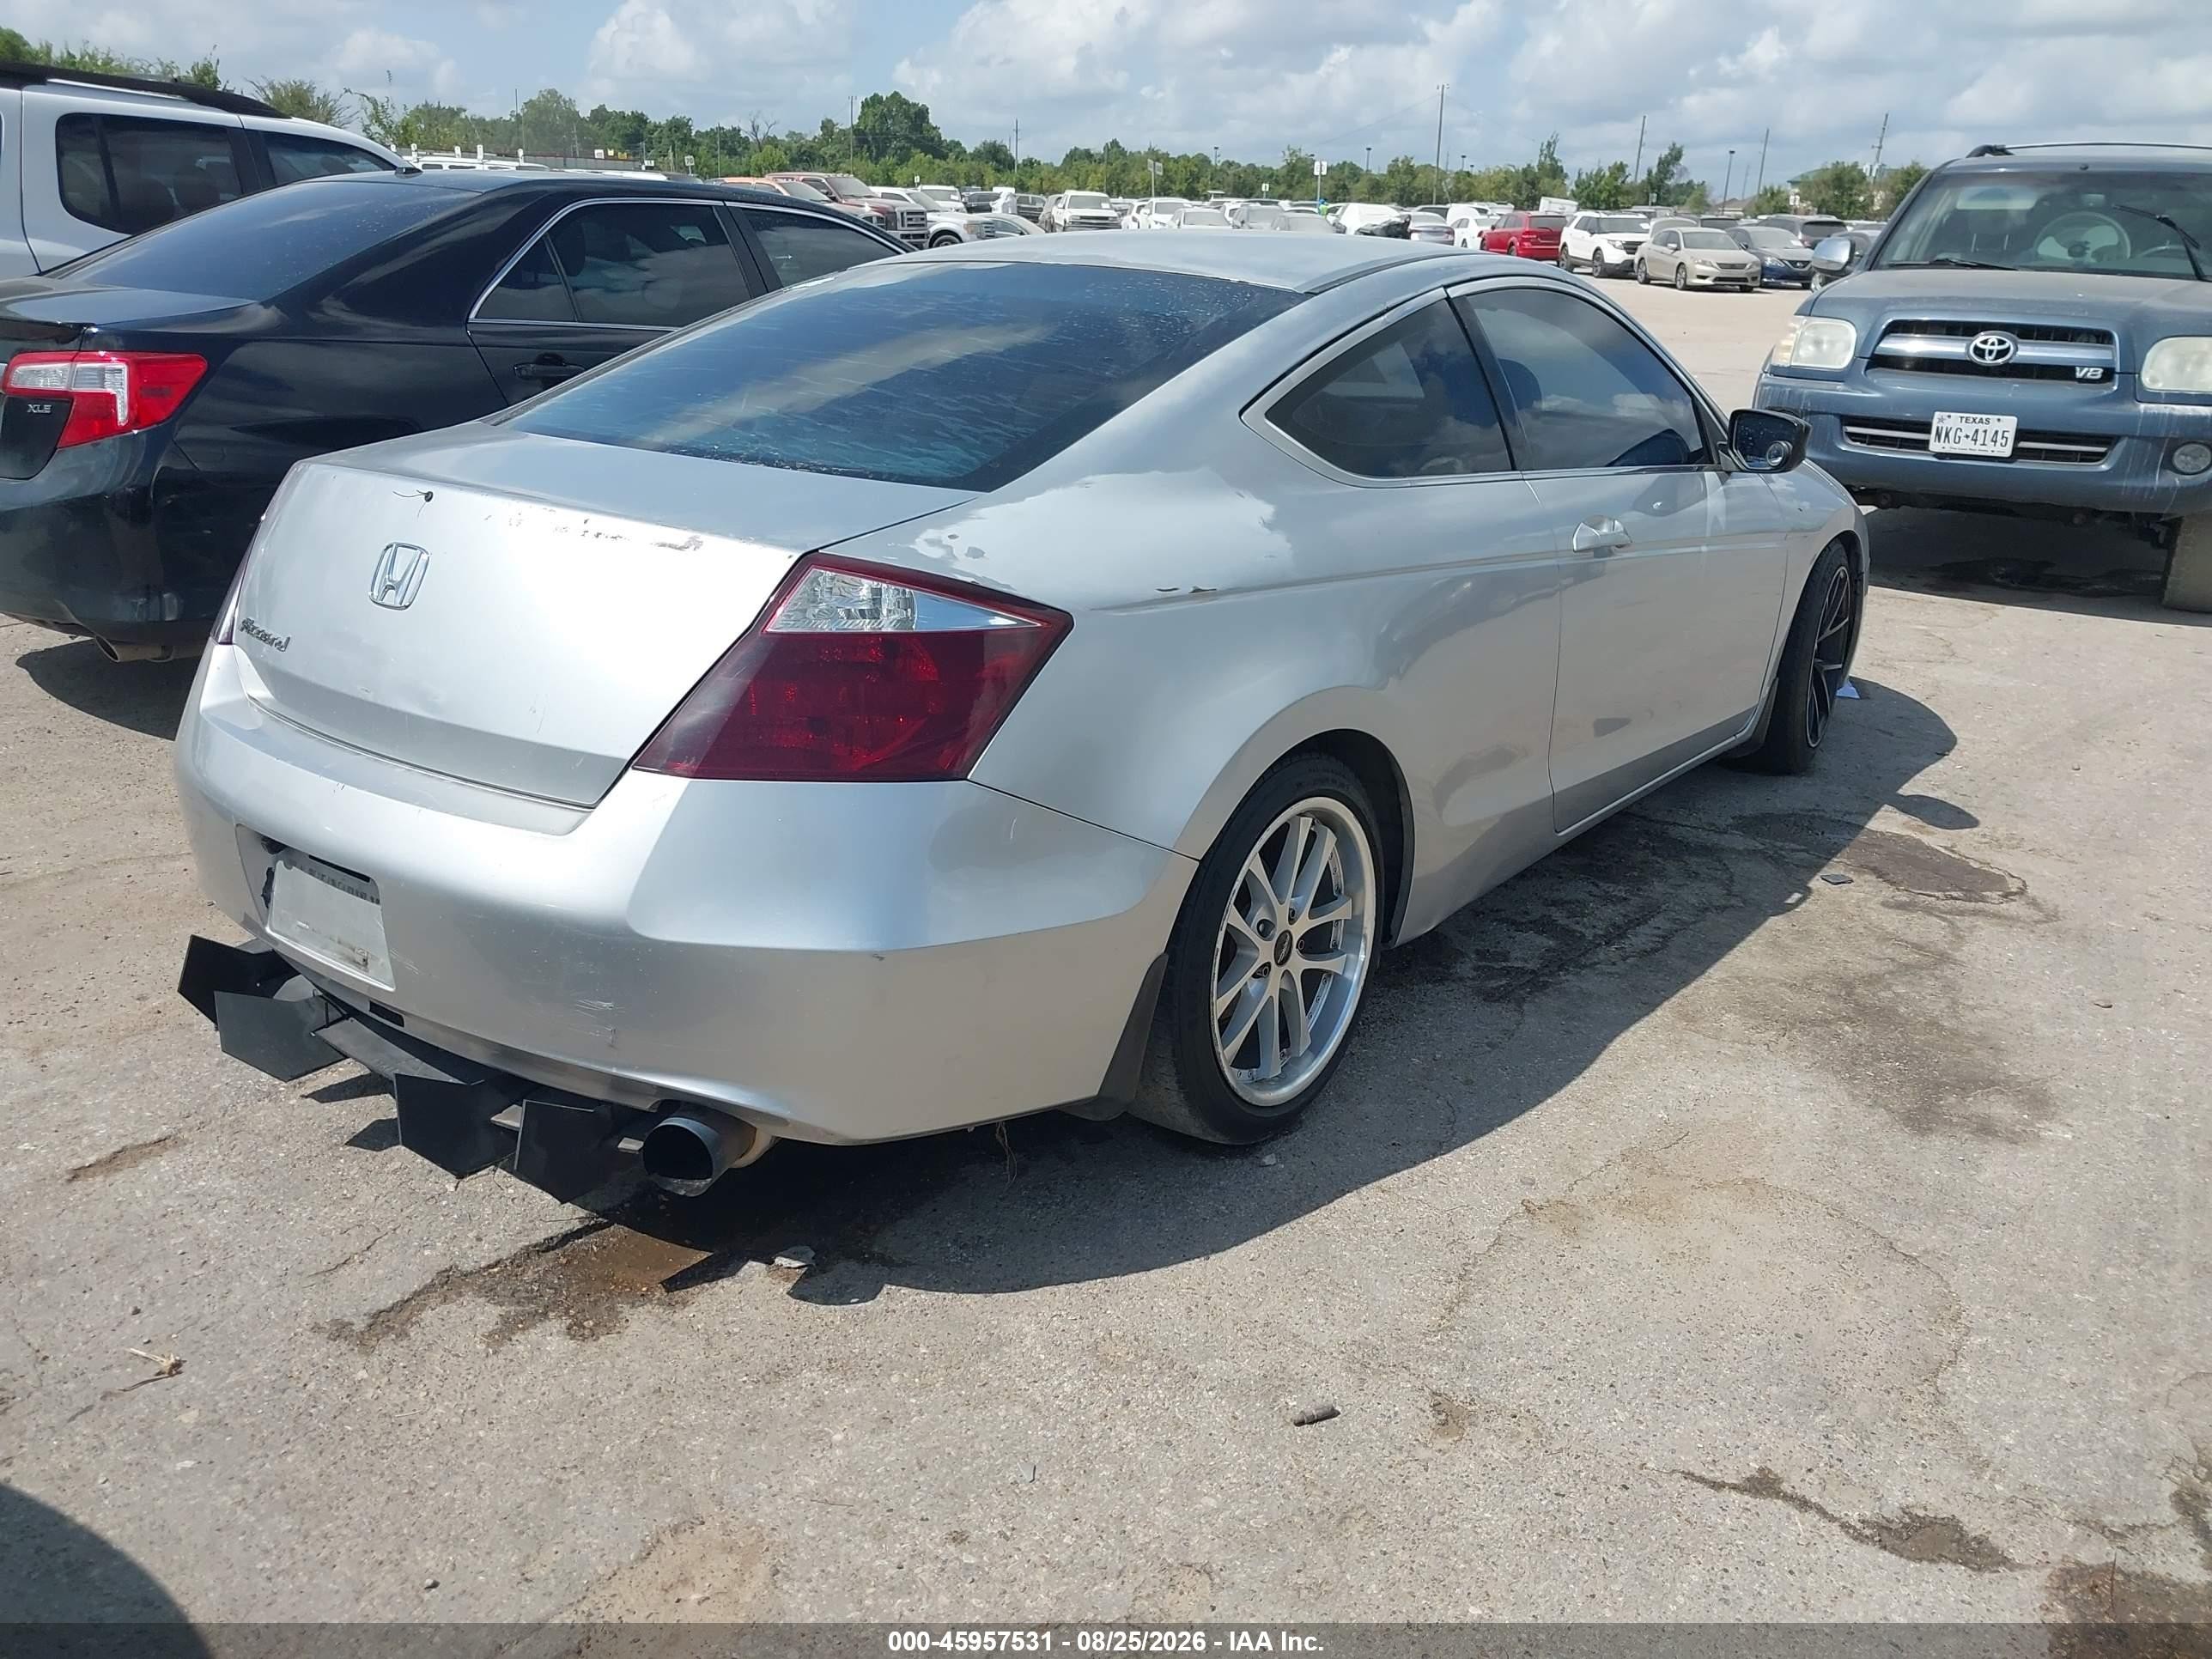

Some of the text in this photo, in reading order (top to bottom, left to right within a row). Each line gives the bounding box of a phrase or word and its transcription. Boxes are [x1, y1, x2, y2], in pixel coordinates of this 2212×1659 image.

[2075, 366, 2103, 379] V8
[27, 404, 52, 413] XLE
[1959, 416, 1990, 425] TEXAS
